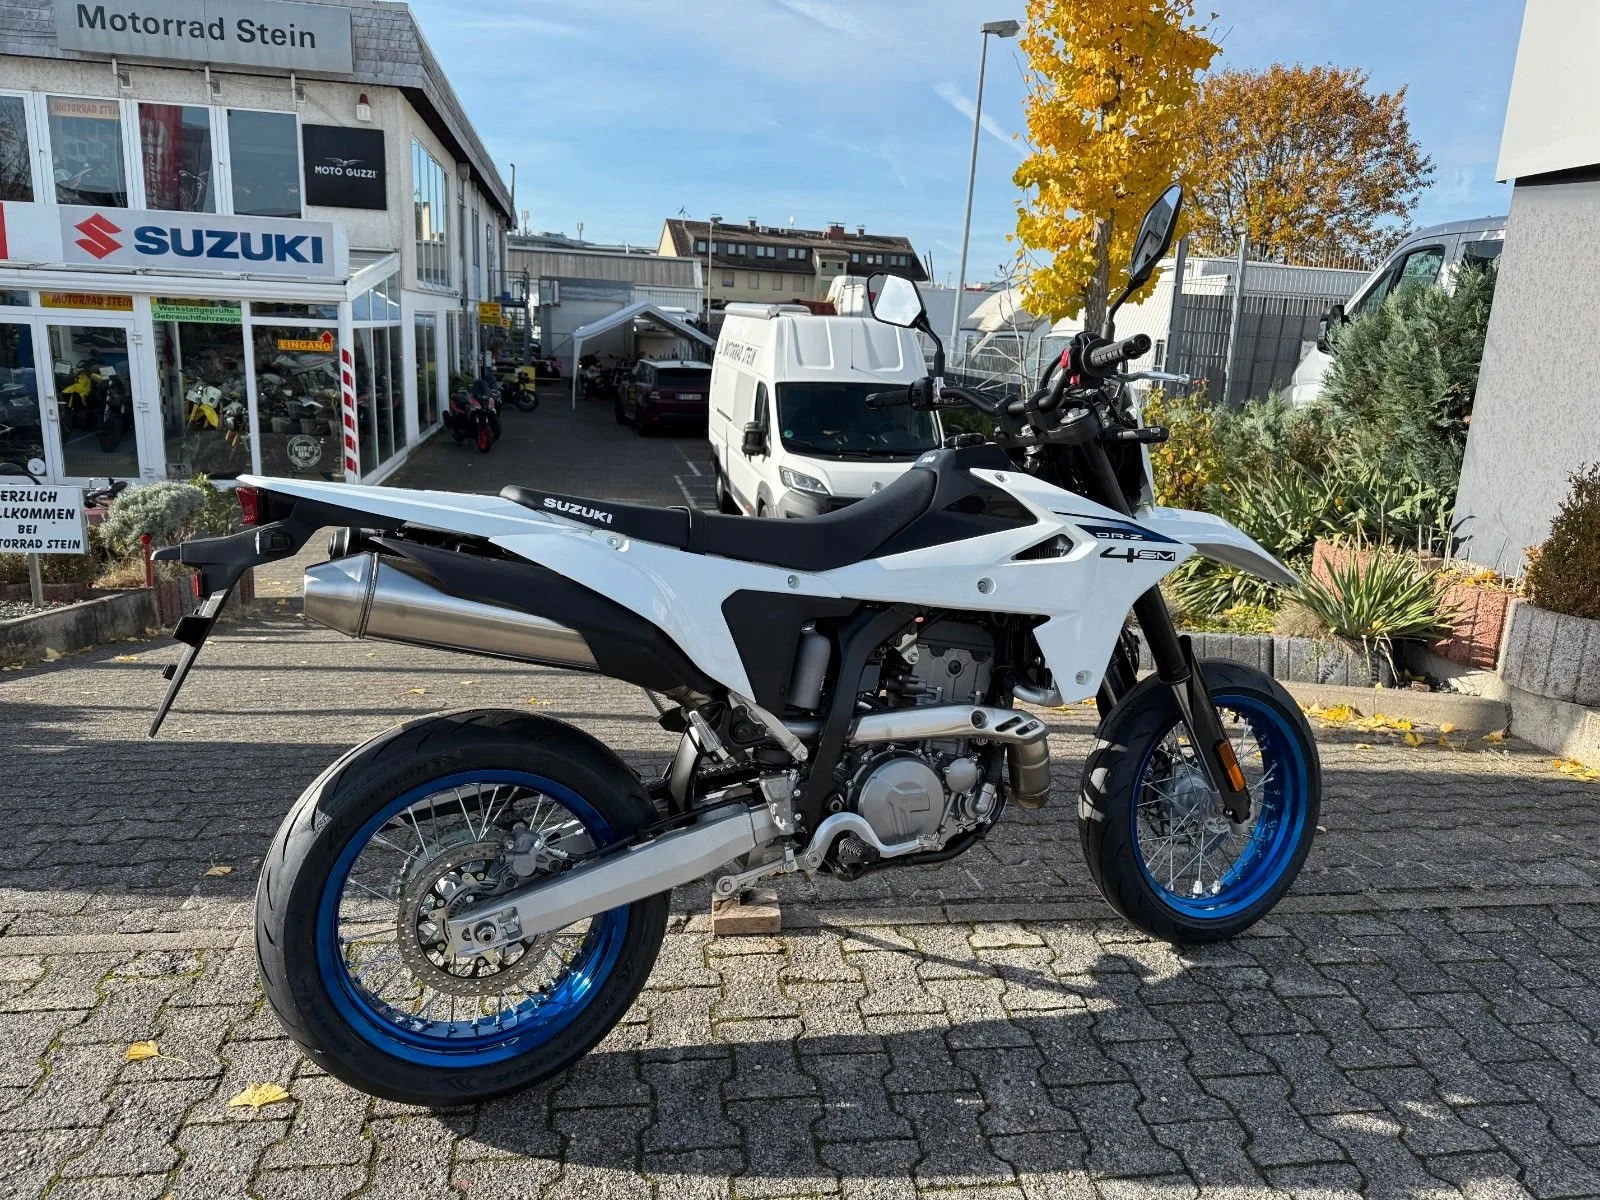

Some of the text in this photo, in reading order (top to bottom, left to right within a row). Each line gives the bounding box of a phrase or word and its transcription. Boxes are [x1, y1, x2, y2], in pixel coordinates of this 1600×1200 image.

[76, 3, 316, 49] Motorrad Stein
[314, 165, 376, 178] MOTO GUZZI
[133, 225, 324, 264] SUZUKI
[52, 294, 133, 306] MOTORRAD STEIN
[280, 340, 331, 350] EINGANG
[0, 508, 75, 519] LKOMMEN
[543, 498, 612, 523] SUZUKI
[18, 525, 37, 534] BEI
[1095, 532, 1143, 540] DR-Z
[47, 539, 80, 549] STEIN
